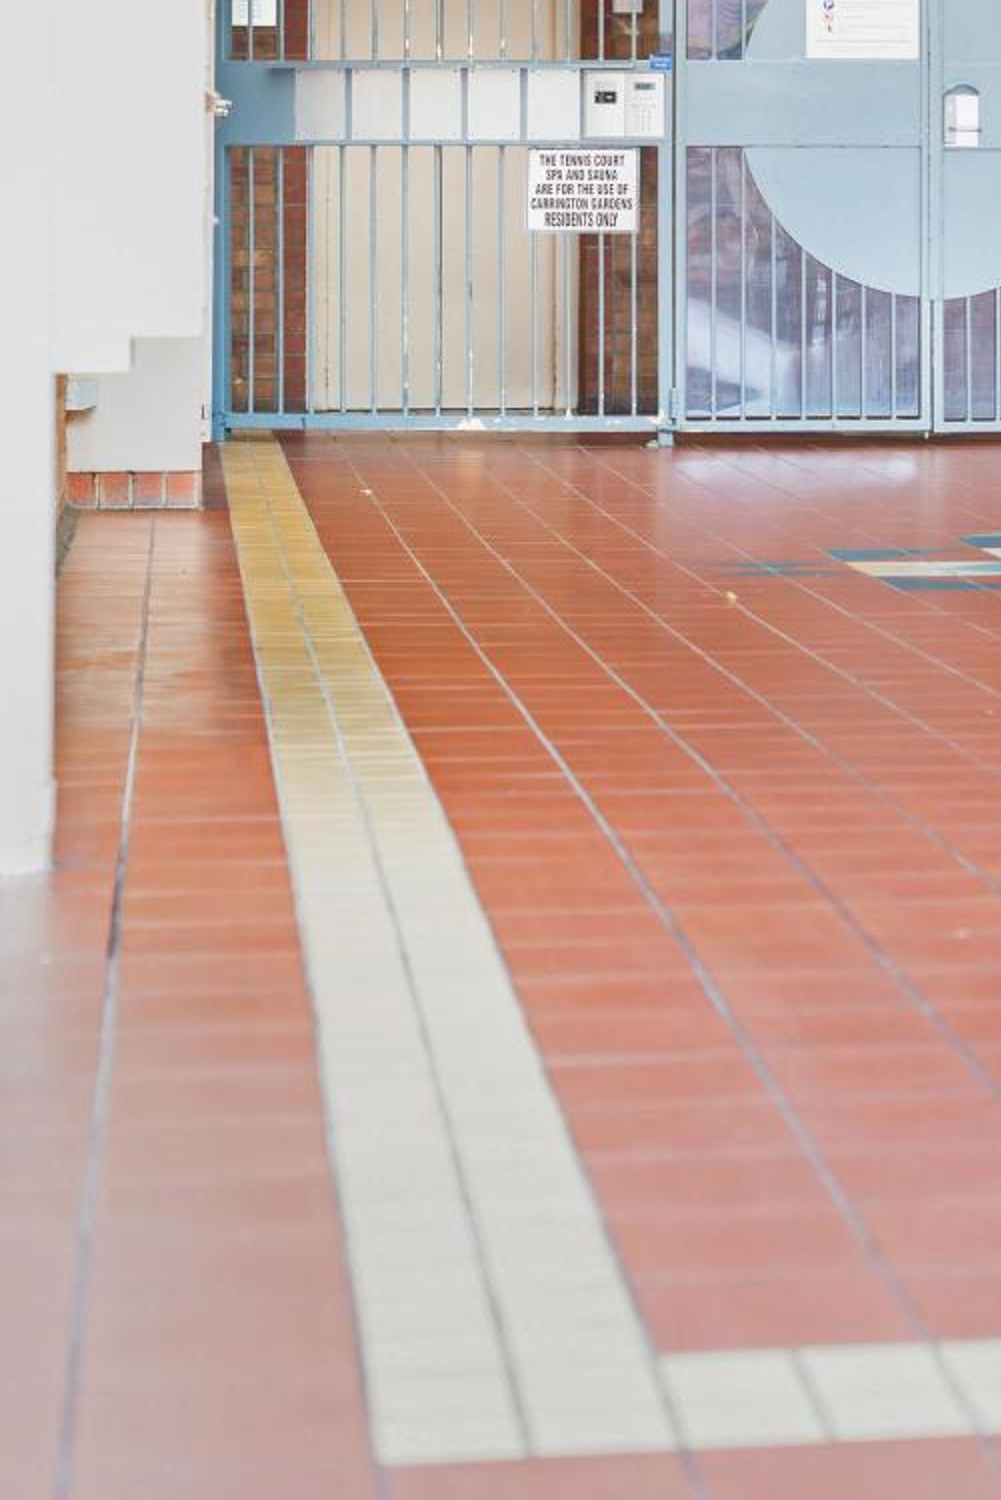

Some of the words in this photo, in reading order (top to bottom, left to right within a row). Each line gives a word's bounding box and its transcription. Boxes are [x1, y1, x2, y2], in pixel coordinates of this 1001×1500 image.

[539, 154, 557, 166] THE
[559, 153, 592, 167] TENNIS
[594, 154, 625, 167] COURT
[545, 169, 563, 181] SPA
[565, 169, 585, 181] AND
[587, 169, 619, 181] SAUNA
[535, 183, 553, 195] ARE
[555, 183, 575, 195] FOR
[577, 183, 594, 195] THE
[596, 183, 615, 195] USE
[617, 183, 629, 195] OF
[530, 197, 589, 210] CARRINGTON
[591, 197, 633, 211] GARDENS
[544, 211, 594, 228] RESIDENTS
[595, 211, 619, 228] ONLY
